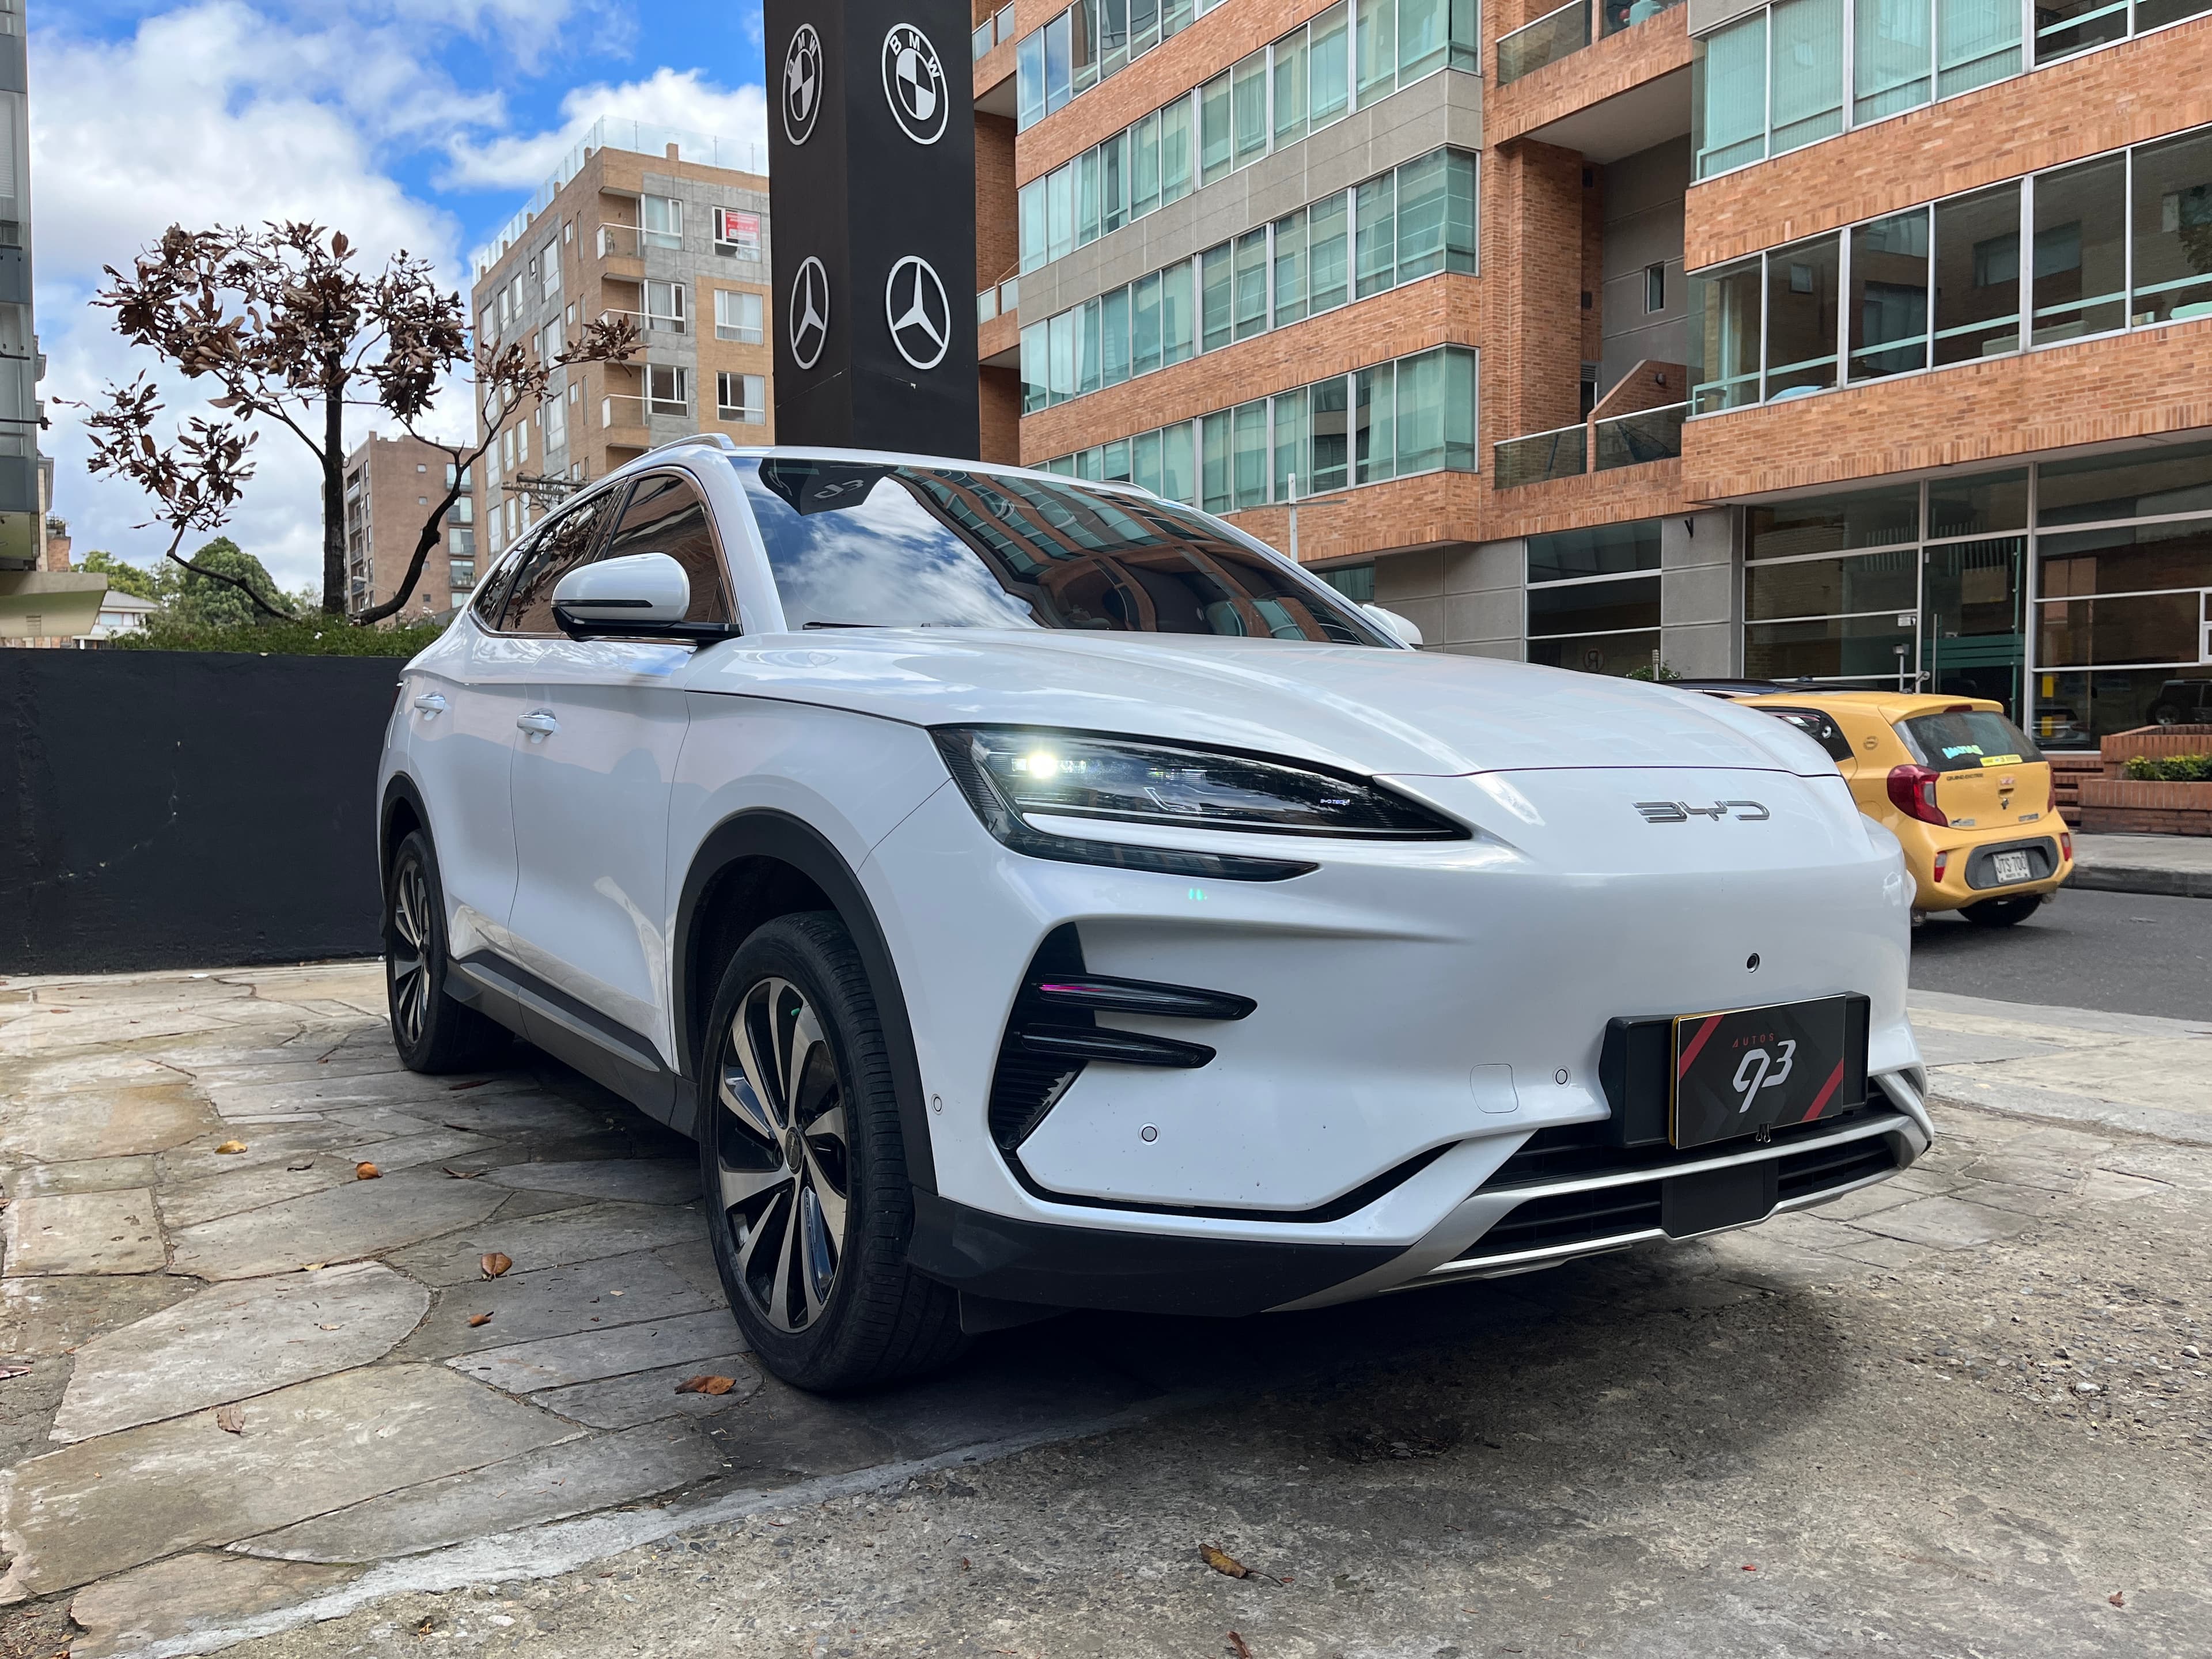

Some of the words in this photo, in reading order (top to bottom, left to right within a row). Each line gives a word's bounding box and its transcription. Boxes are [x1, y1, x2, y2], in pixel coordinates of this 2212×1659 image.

[787, 32, 817, 78] BMW
[889, 31, 941, 78] BMW
[1631, 800, 1770, 823] BYD
[1732, 1033, 1775, 1048] AUTOS
[1733, 1039, 1797, 1113] 93
